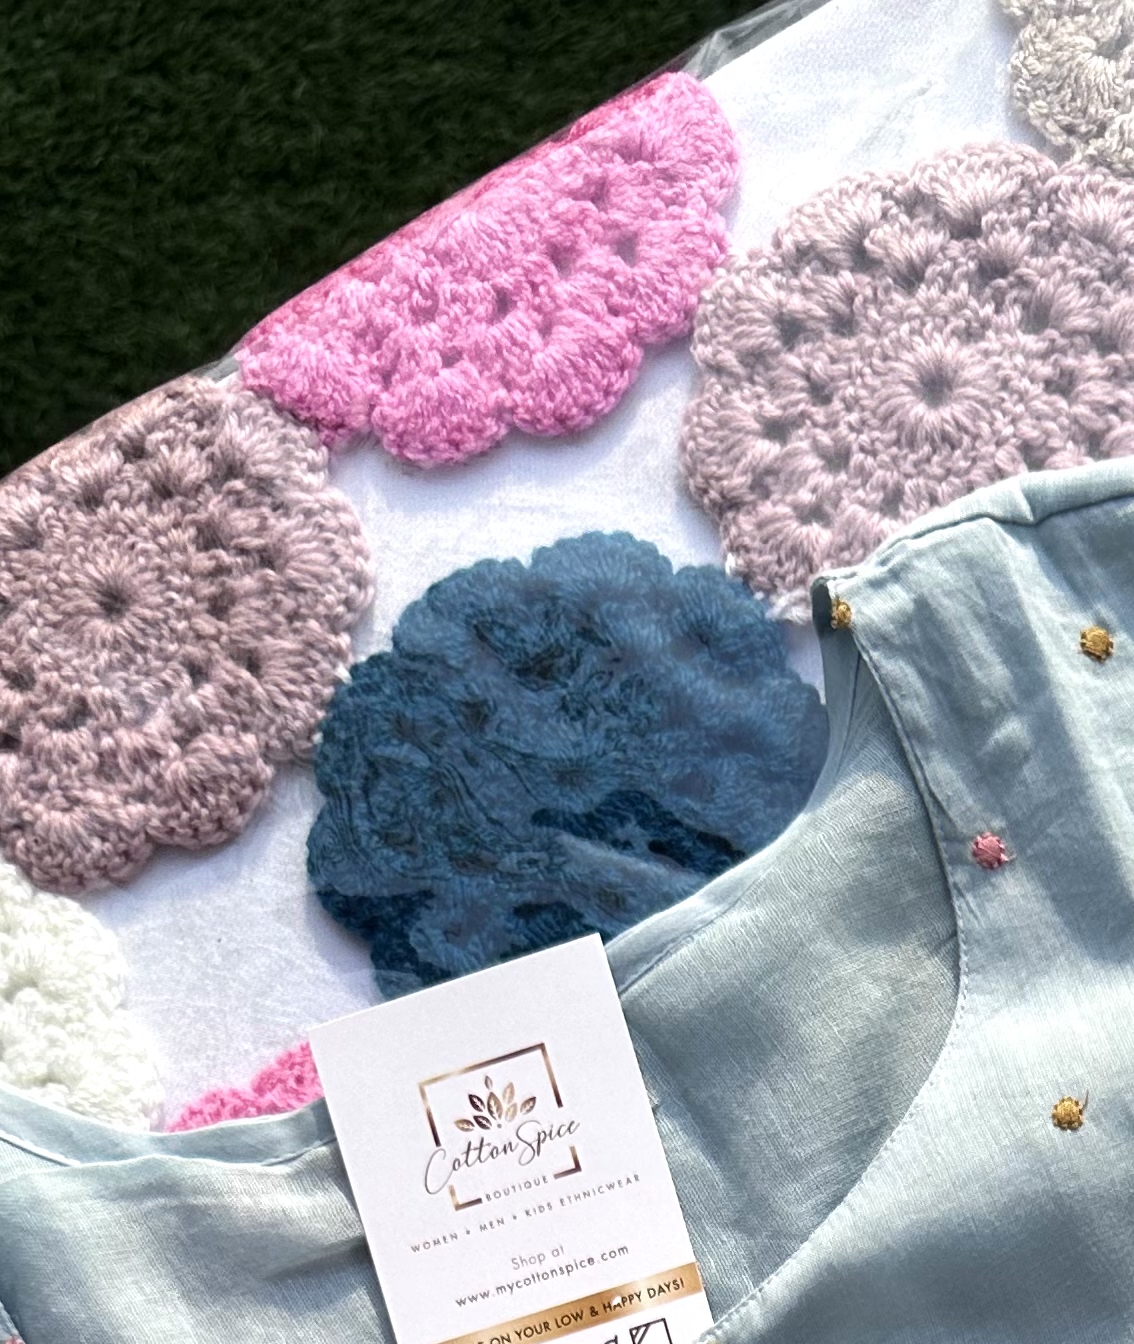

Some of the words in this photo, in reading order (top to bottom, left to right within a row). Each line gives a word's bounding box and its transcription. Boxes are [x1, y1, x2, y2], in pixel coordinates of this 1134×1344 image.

[411, 1232, 459, 1253] WOMEN
[479, 1217, 506, 1233] MEN
[525, 1202, 553, 1218] KIDS
[560, 1174, 641, 1207] ETHNICWEAR
[486, 1175, 549, 1202] BOUTIQUE
[455, 1244, 630, 1309] www.mycottonspice.com
[511, 1252, 546, 1271] Shop
[552, 1245, 565, 1259] at
[514, 1321, 552, 1340] YOUR
[555, 1310, 585, 1329] LOW
[589, 1306, 600, 1318] &
[646, 1277, 685, 1299] DAYS!
